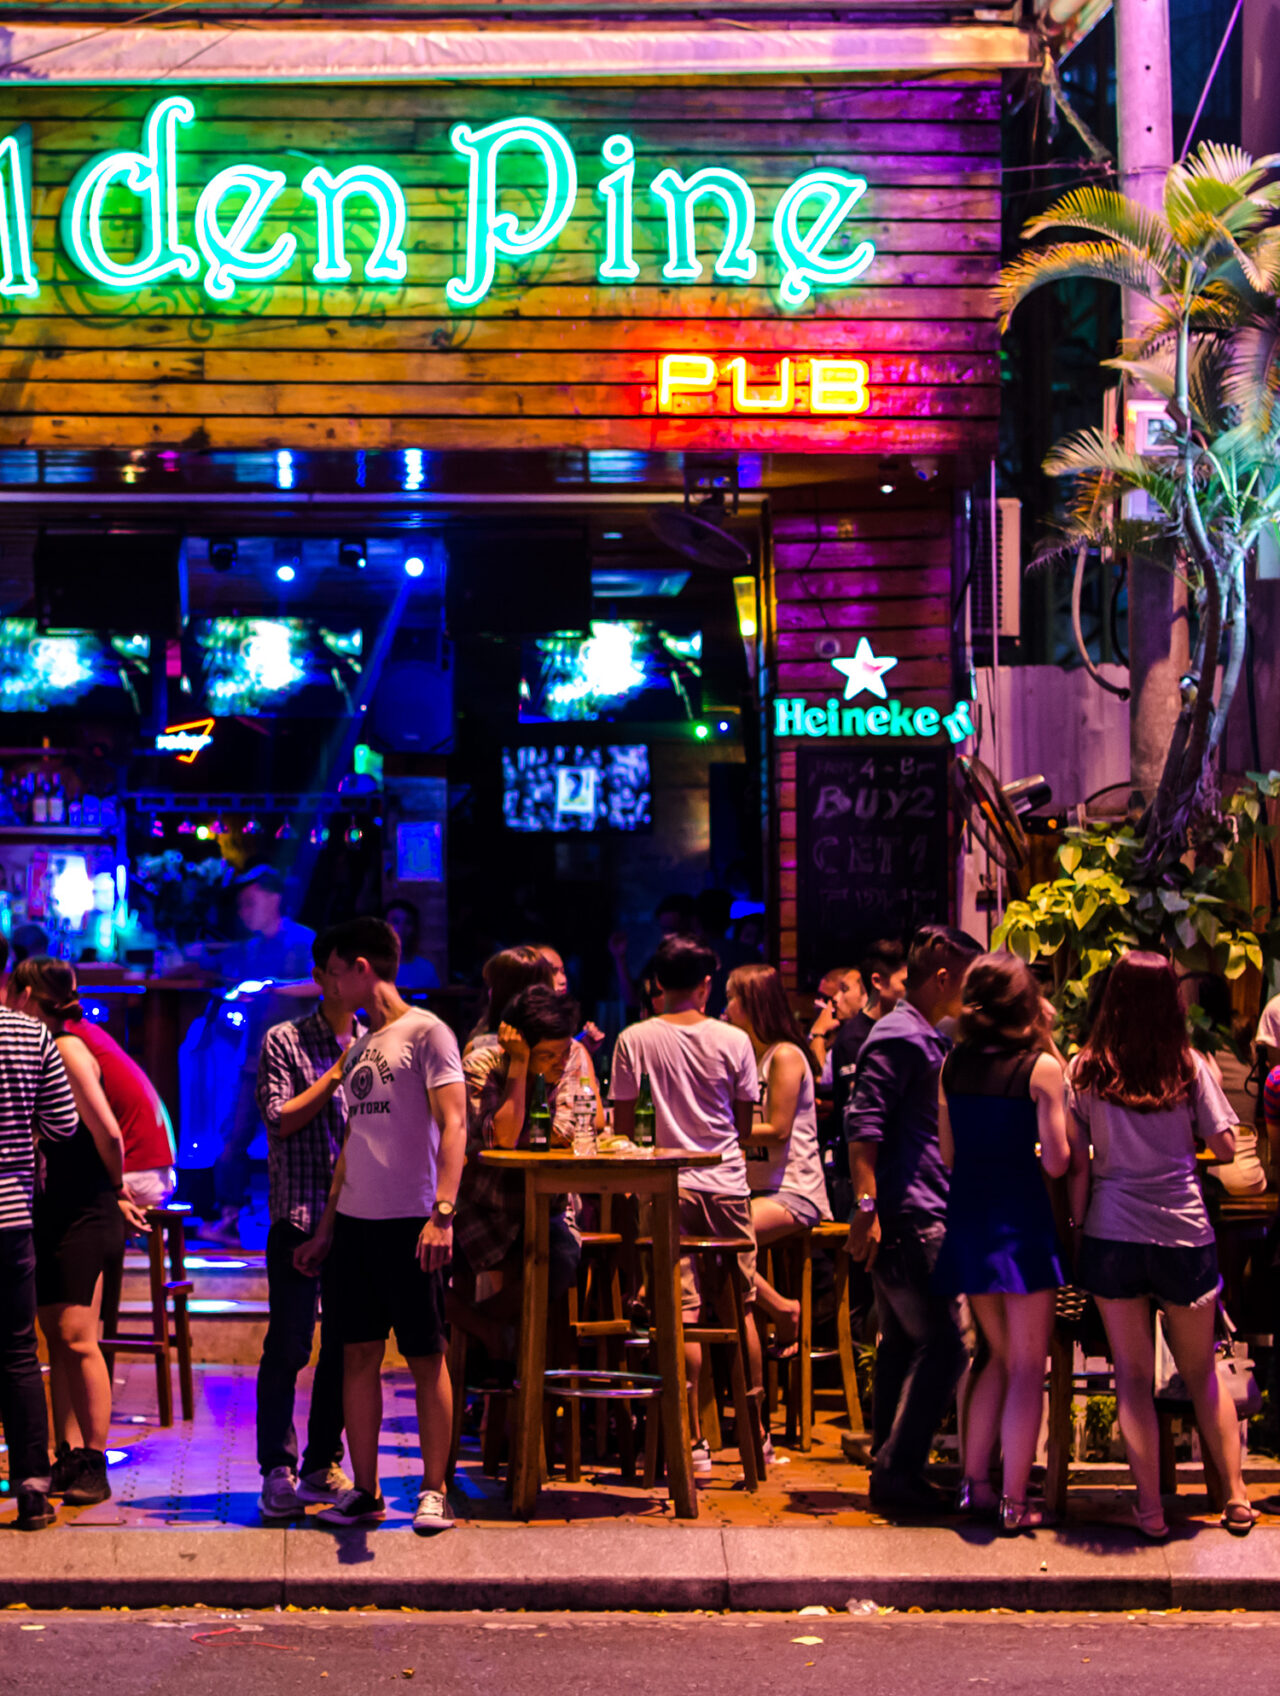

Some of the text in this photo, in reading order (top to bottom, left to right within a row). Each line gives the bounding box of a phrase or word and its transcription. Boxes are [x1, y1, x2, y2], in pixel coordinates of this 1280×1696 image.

[445, 116, 876, 306] Pine
[657, 352, 871, 416] PUB
[773, 697, 976, 744] Heineken
